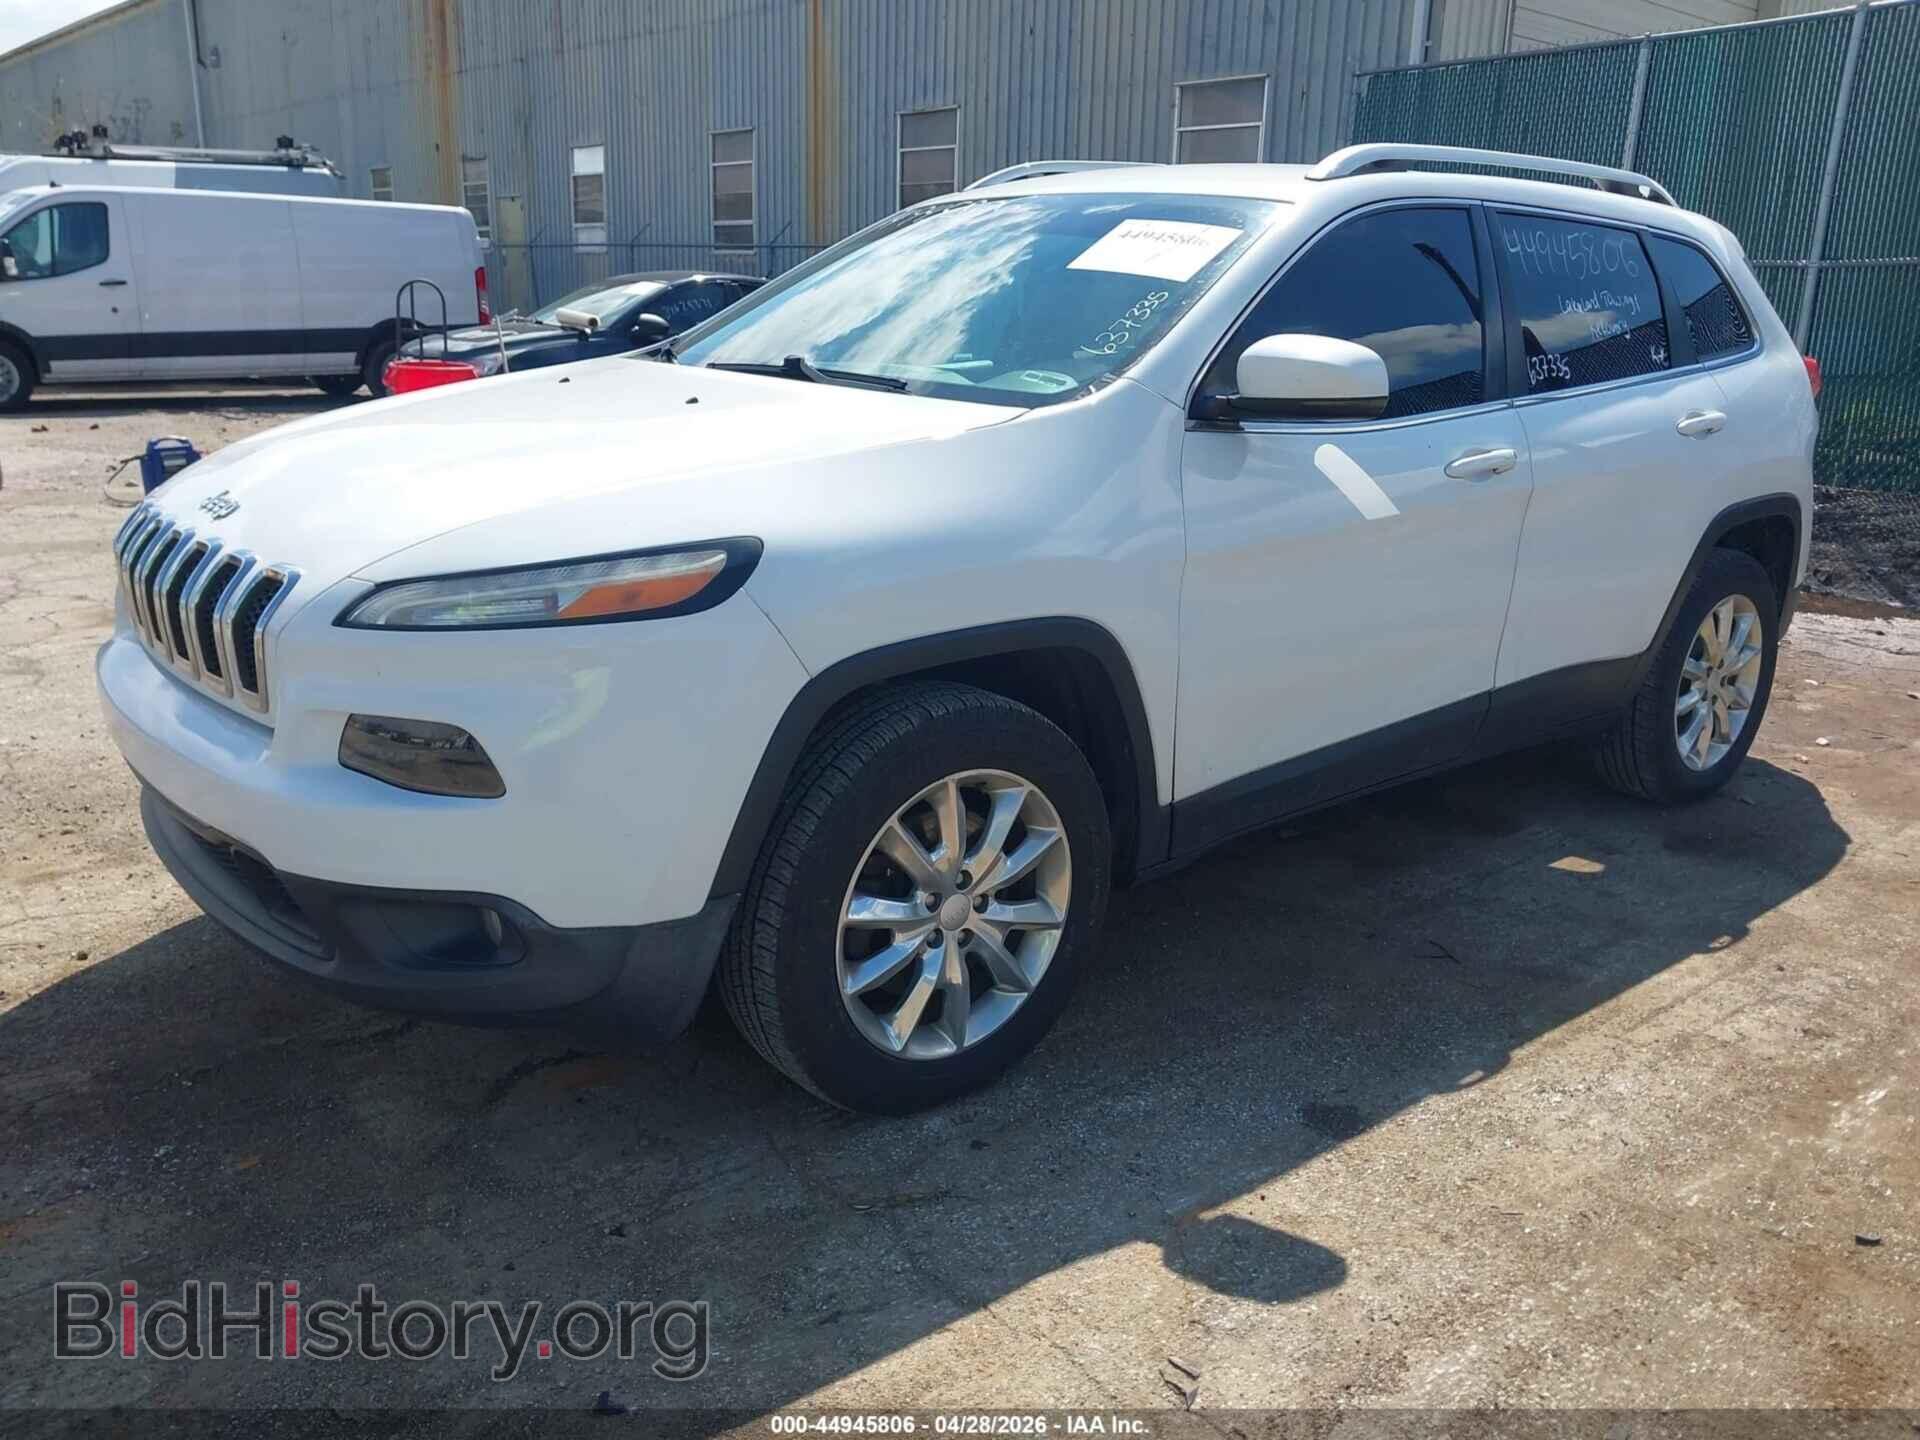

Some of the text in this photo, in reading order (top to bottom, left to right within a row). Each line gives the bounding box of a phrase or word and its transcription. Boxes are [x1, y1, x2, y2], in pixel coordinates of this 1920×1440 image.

[1502, 224, 1640, 281] 44945806
[1079, 290, 1169, 357] 637335
[1526, 353, 1571, 385] 637335
